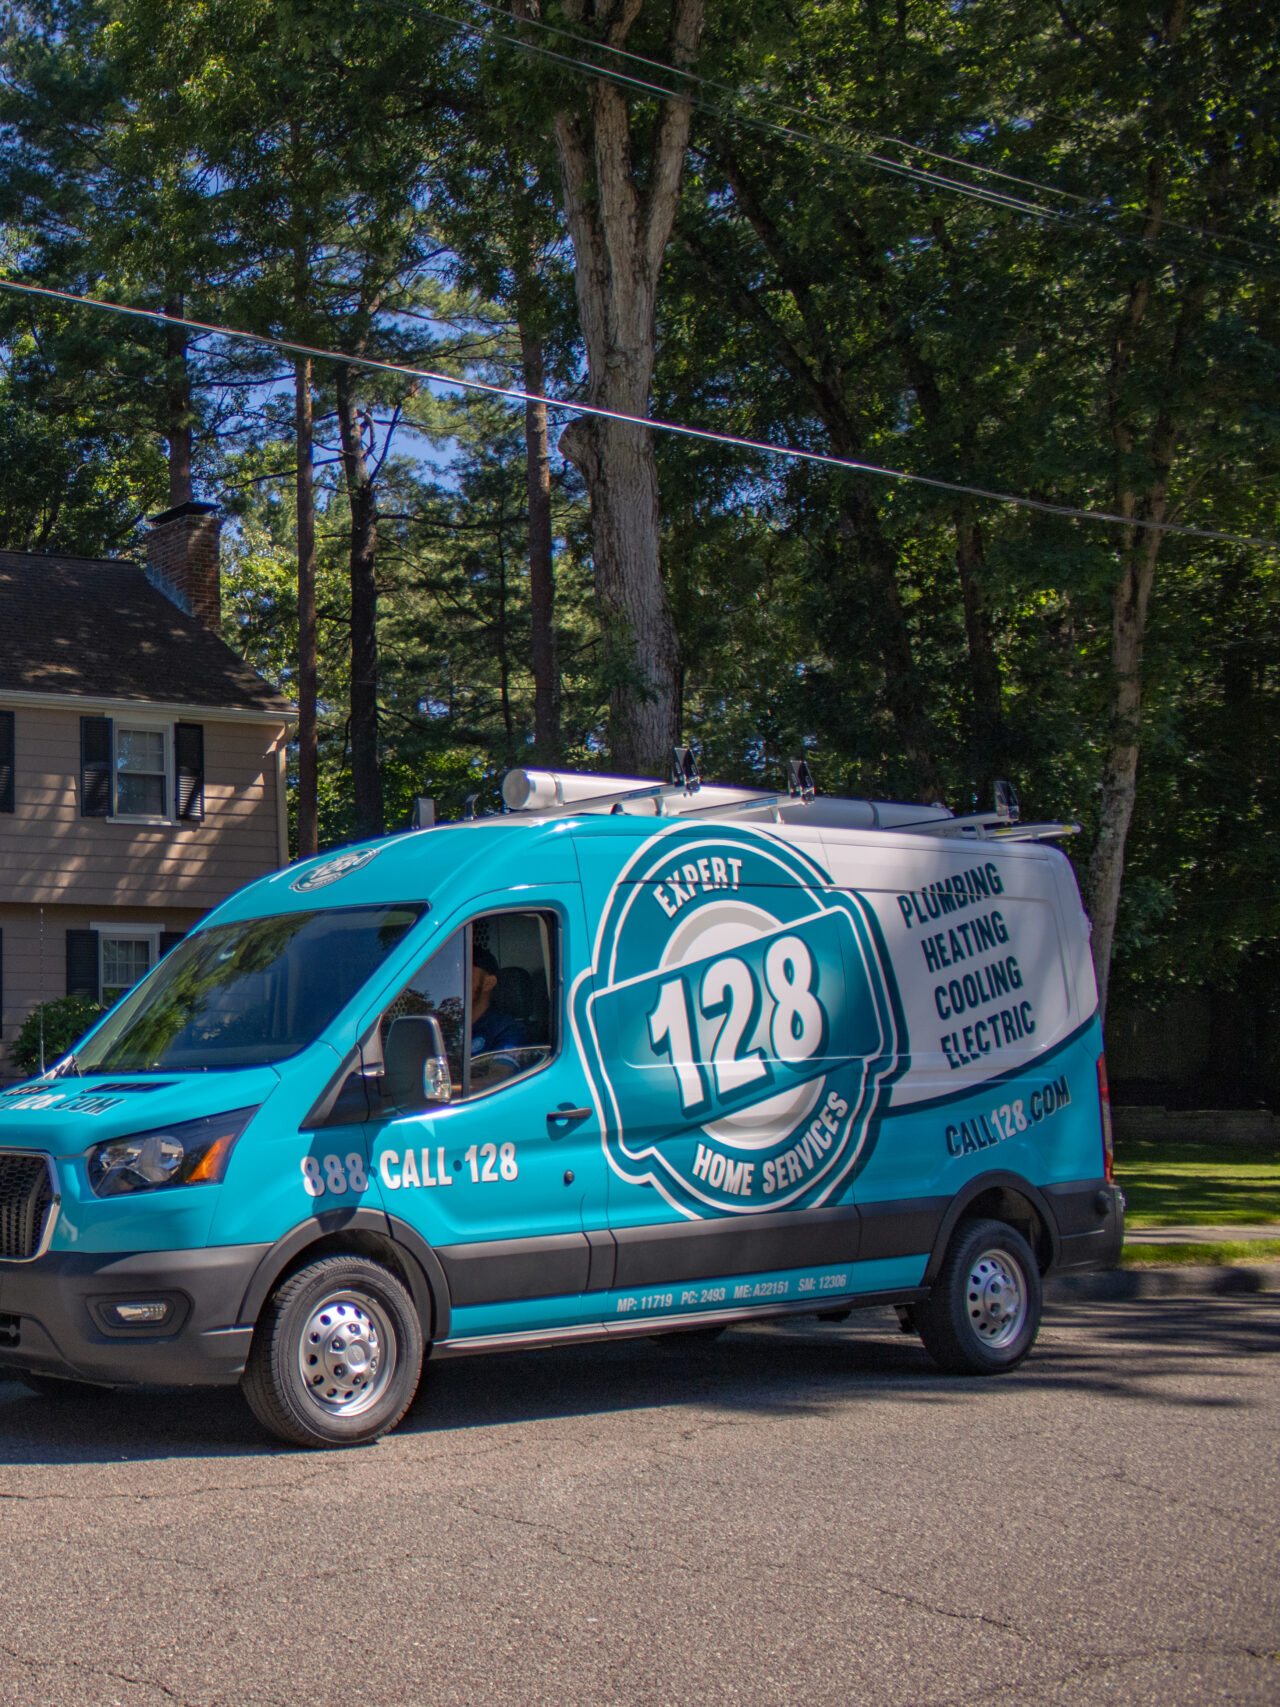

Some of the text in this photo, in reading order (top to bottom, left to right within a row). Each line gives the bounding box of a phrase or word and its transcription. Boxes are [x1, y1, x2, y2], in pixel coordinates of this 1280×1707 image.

[652, 856, 742, 918] EXPERT
[896, 862, 1004, 929] PLUMBING
[921, 910, 1009, 973] HEATING
[934, 956, 1023, 1020] COOLING
[647, 933, 824, 1111] 128
[940, 1001, 1036, 1070] ELECTRIC
[692, 1091, 848, 1196] HOME SERVICES
[945, 1075, 1072, 1159] CALL128.COM
[301, 1142, 518, 1197] 888 CALL 128
[617, 1274, 847, 1312] MP: 11719 PC: 2493 ME: A22151 SM: 12306
